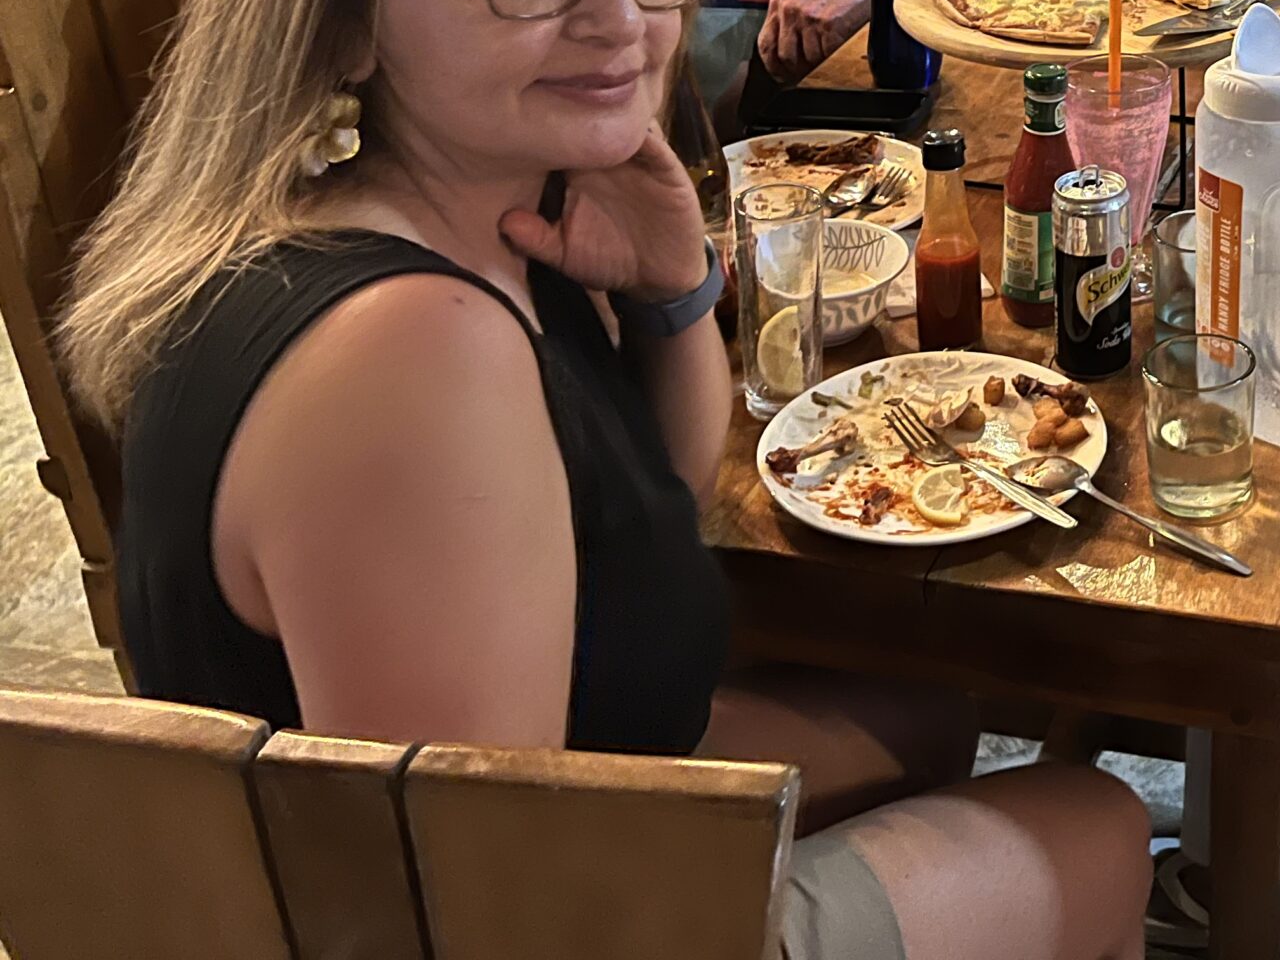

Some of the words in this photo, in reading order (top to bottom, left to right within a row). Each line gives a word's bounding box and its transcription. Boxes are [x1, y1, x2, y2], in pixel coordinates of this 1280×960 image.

[1219, 217, 1232, 255] BOTTLE
[1218, 256, 1231, 295] FRIDGE
[1217, 296, 1231, 332] HANDY
